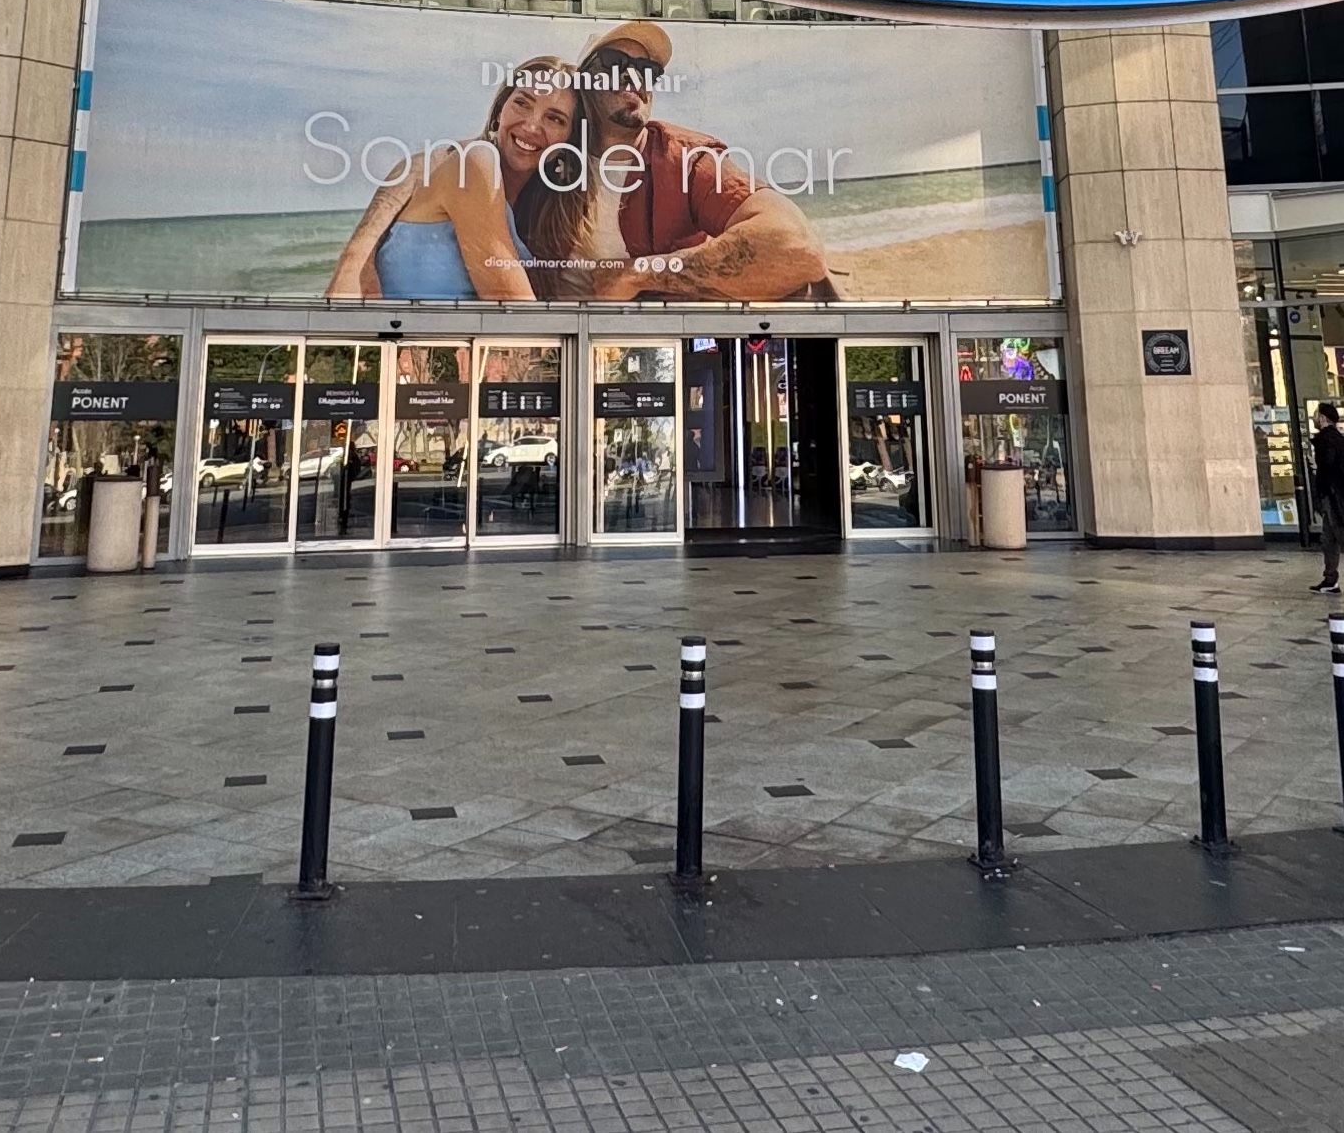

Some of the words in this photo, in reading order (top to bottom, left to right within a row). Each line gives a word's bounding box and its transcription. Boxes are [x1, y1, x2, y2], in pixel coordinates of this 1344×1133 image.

[481, 61, 620, 96] Diagonal
[625, 66, 687, 93] Mar
[301, 110, 502, 189] Som
[537, 118, 647, 193] de
[681, 144, 853, 196] mar
[484, 256, 625, 270] diagonalmarcentre.com
[71, 396, 129, 409] PONENT
[998, 393, 1047, 405] PONENT
